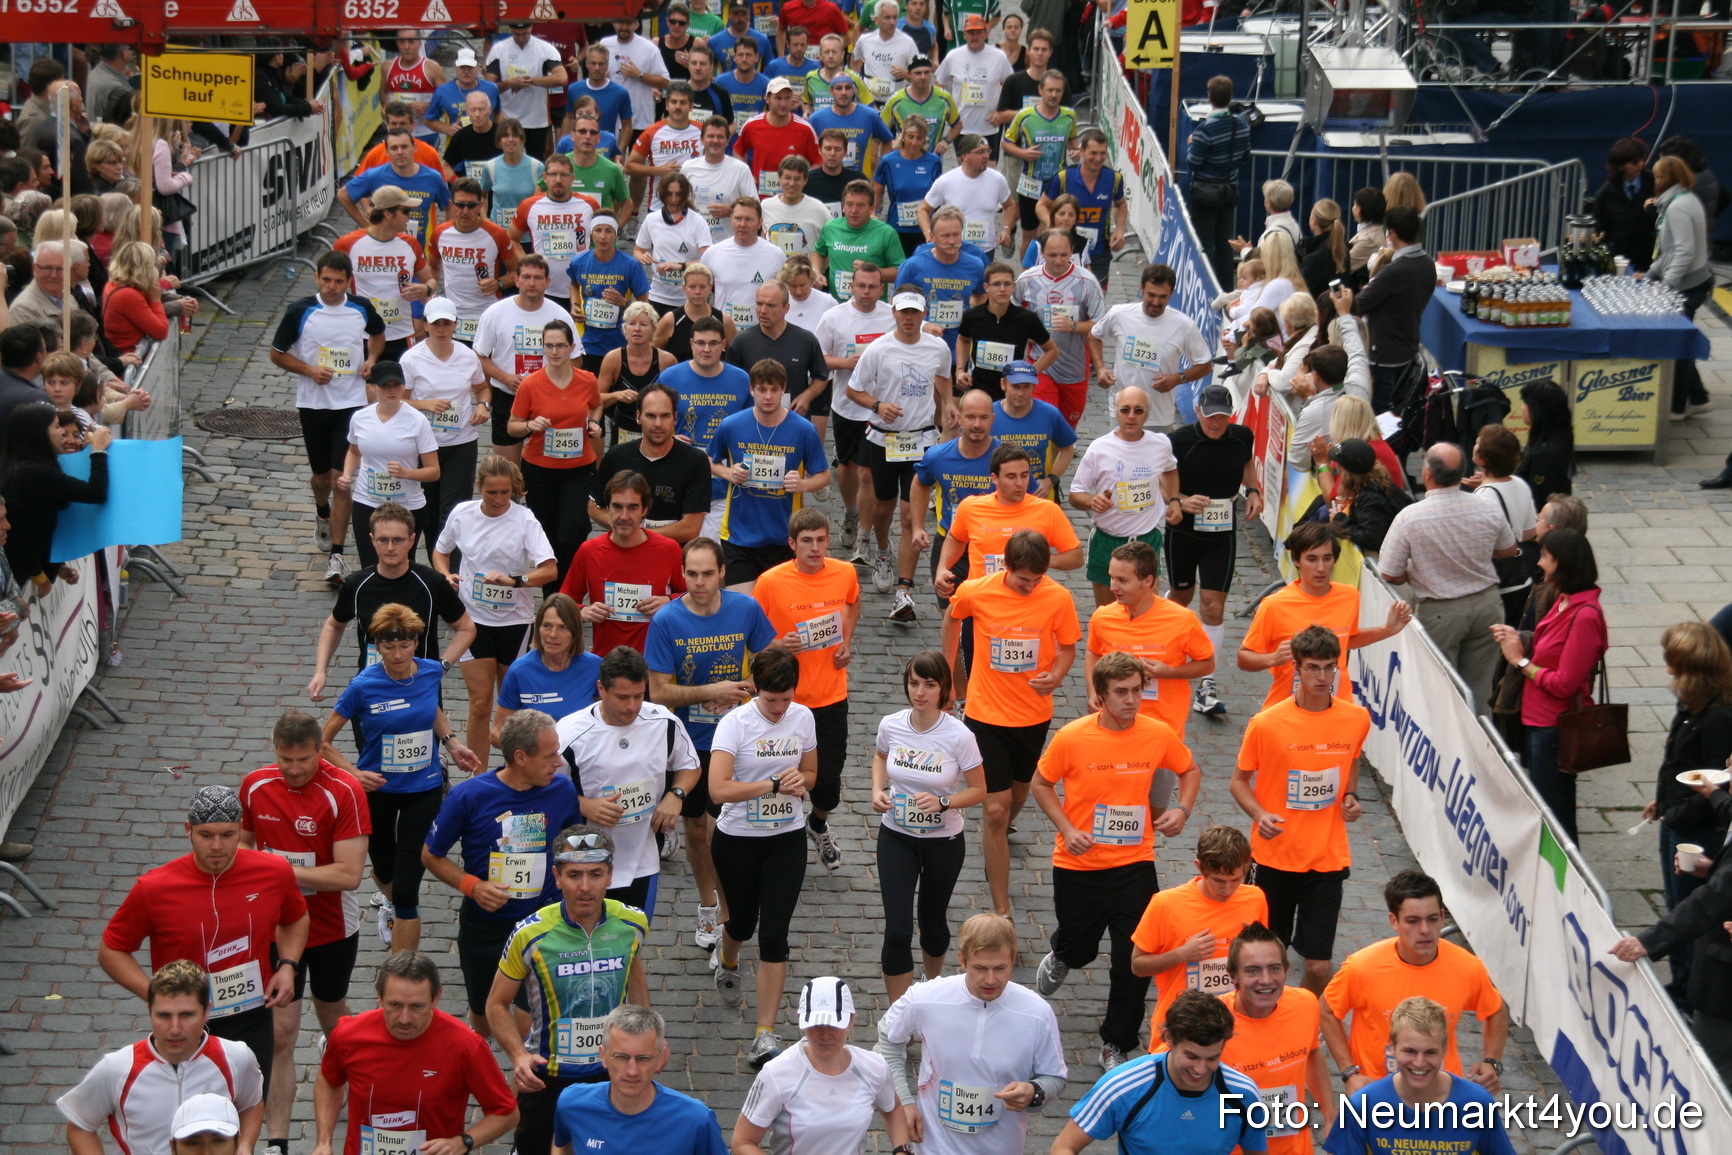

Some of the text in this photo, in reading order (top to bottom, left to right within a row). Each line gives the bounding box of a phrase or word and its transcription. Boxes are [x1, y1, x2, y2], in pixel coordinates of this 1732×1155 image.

[345, 0, 400, 18] 6352
[1137, 10, 1168, 50] A
[150, 64, 246, 87] Schnupper-
[391, 75, 423, 89] ITALIA
[183, 87, 213, 103] lauf
[970, 91, 983, 99] 435
[659, 140, 698, 151] MERZ
[1022, 182, 1038, 192] 3195
[537, 213, 584, 225] MERZ
[966, 230, 985, 238] 2937
[552, 241, 574, 250] 2880
[784, 242, 794, 250] 11
[832, 241, 868, 254] Sinupret
[441, 246, 487, 259] MERZ
[357, 255, 407, 268] MERZ
[589, 273, 625, 281] NEUMARKTER
[933, 277, 971, 286] NEUMARKTER
[383, 308, 399, 318] 520
[593, 310, 614, 320] 2267
[733, 313, 753, 323] 2441
[939, 309, 959, 319] 2171
[329, 350, 349, 358] Markus
[986, 352, 1009, 363] 3861
[1134, 349, 1157, 360] 3733
[332, 359, 351, 370] 104
[1576, 363, 1658, 403] Glossner
[679, 393, 737, 402] 10. NEUMARKTER
[1617, 385, 1655, 402] Bier
[688, 399, 728, 407] STADTLAUF
[436, 412, 459, 424] 2840
[1000, 433, 1048, 441] NEUMARKTER
[555, 440, 579, 448] 2456
[747, 442, 796, 454] NEUMARKTER
[900, 443, 918, 452] 594
[754, 457, 774, 465] Michael
[754, 467, 780, 478] 2514
[942, 473, 951, 481] 10.
[377, 481, 402, 491] 3755
[950, 481, 991, 490] STADTLAUF
[1127, 482, 1150, 491] Hartmut
[1132, 490, 1152, 503] 236
[1205, 510, 1229, 520] 2316
[485, 588, 513, 599] 3715
[617, 586, 639, 595] Michael
[809, 615, 836, 629] Bernhard
[812, 624, 838, 641] 2962
[675, 632, 745, 646] 10. NEUMARKTER
[686, 642, 735, 654] STADTLAUF
[1004, 649, 1033, 660] 3314
[397, 737, 413, 745] Anita
[397, 745, 428, 760] 3392
[919, 762, 942, 774] viertl
[1303, 774, 1323, 782] Daniel
[618, 786, 640, 796] Tobias
[1303, 783, 1334, 797] 2964
[621, 792, 652, 810] 3126
[762, 802, 793, 816] 2046
[1109, 808, 1134, 817] Thomas
[908, 811, 942, 824] 2045
[1109, 819, 1139, 831] 2960
[505, 857, 527, 866] Erwin
[514, 870, 532, 884] 51
[218, 943, 238, 956] DEHN
[558, 950, 589, 959] TEAM
[557, 956, 625, 976] BOCK
[1203, 963, 1227, 972] Philipp
[214, 971, 244, 985] Thomas
[217, 979, 256, 1001] 2525
[576, 1022, 605, 1031] Thomas
[1243, 1063, 1265, 1072] stark
[956, 1087, 979, 1100] Oliver
[956, 1102, 995, 1116] 3414
[383, 1115, 404, 1124] DEHN
[377, 1132, 406, 1145] Ottmar
[587, 1138, 605, 1150] MIT
[1376, 1137, 1472, 1151] 10. NEUMARKTER
